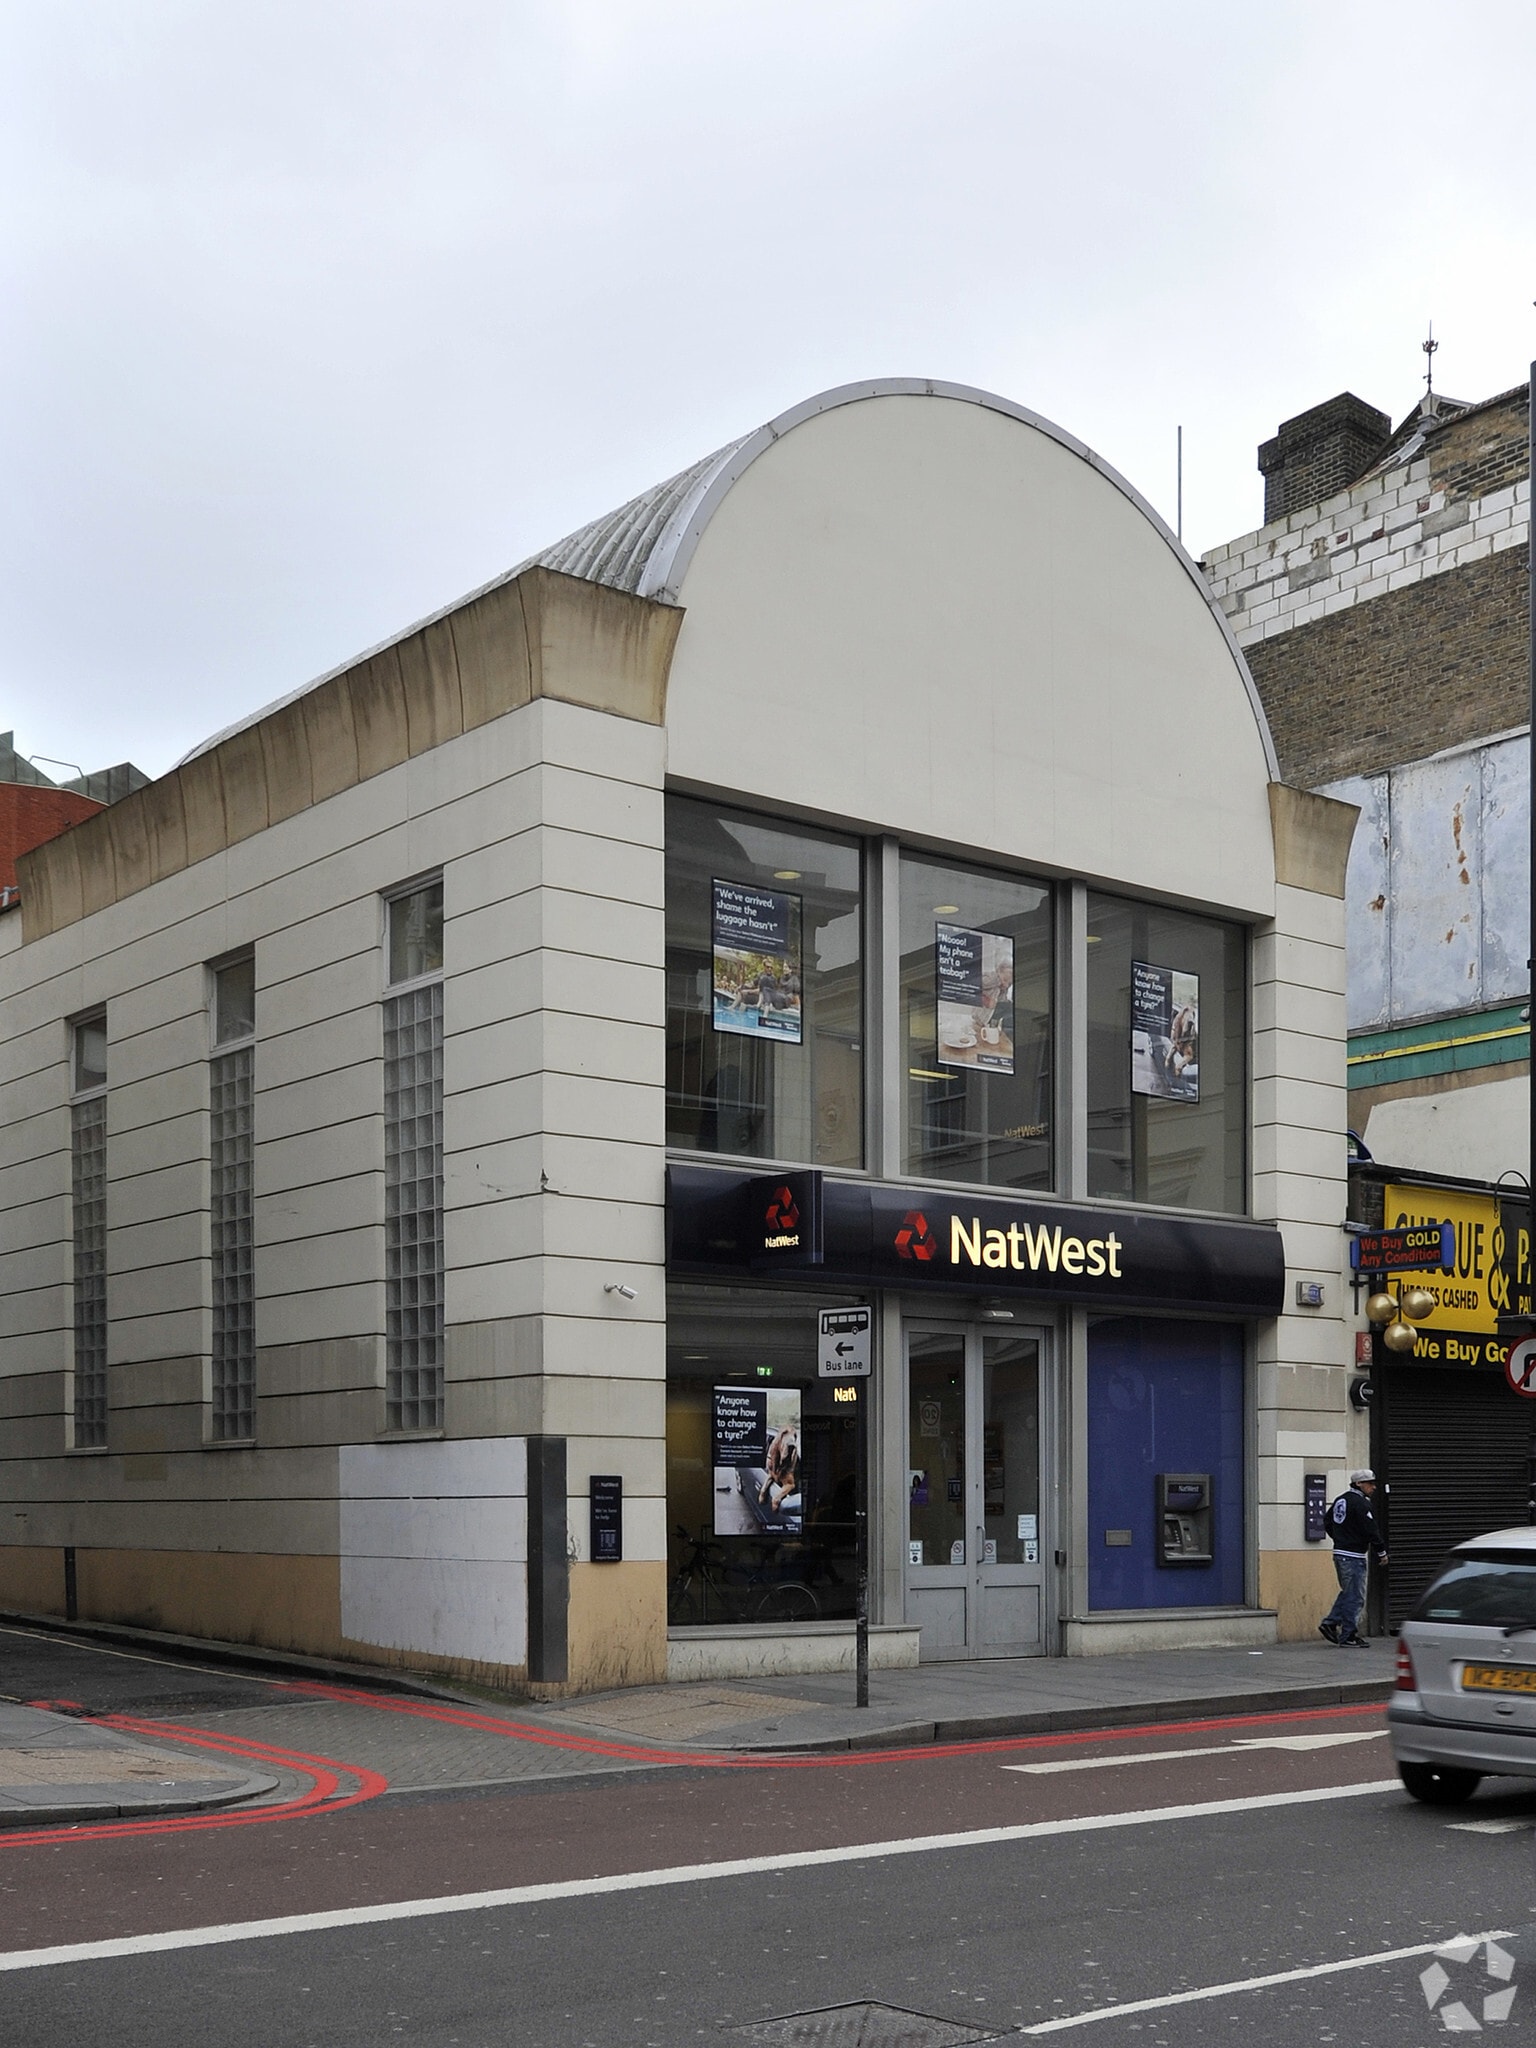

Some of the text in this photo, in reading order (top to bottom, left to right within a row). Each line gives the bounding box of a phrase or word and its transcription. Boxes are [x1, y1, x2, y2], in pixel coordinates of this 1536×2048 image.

[716, 899, 758, 917] shame the
[745, 896, 775, 910] arrived,
[716, 910, 748, 927] luggage
[939, 944, 974, 959] My phone
[939, 954, 954, 966] isn't
[765, 1234, 800, 1249] NatWest
[951, 1214, 1123, 1278] NatWest
[1360, 1230, 1440, 1251] We Buy GOLD
[1360, 1248, 1440, 1268] Any Condition
[1442, 1287, 1479, 1310] CASHED
[1413, 1337, 1440, 1359] We
[1446, 1339, 1480, 1366] Buy
[825, 1360, 863, 1371] Bus lane
[717, 1405, 757, 1417] know how
[717, 1418, 757, 1431] to change
[717, 1431, 723, 1439] a
